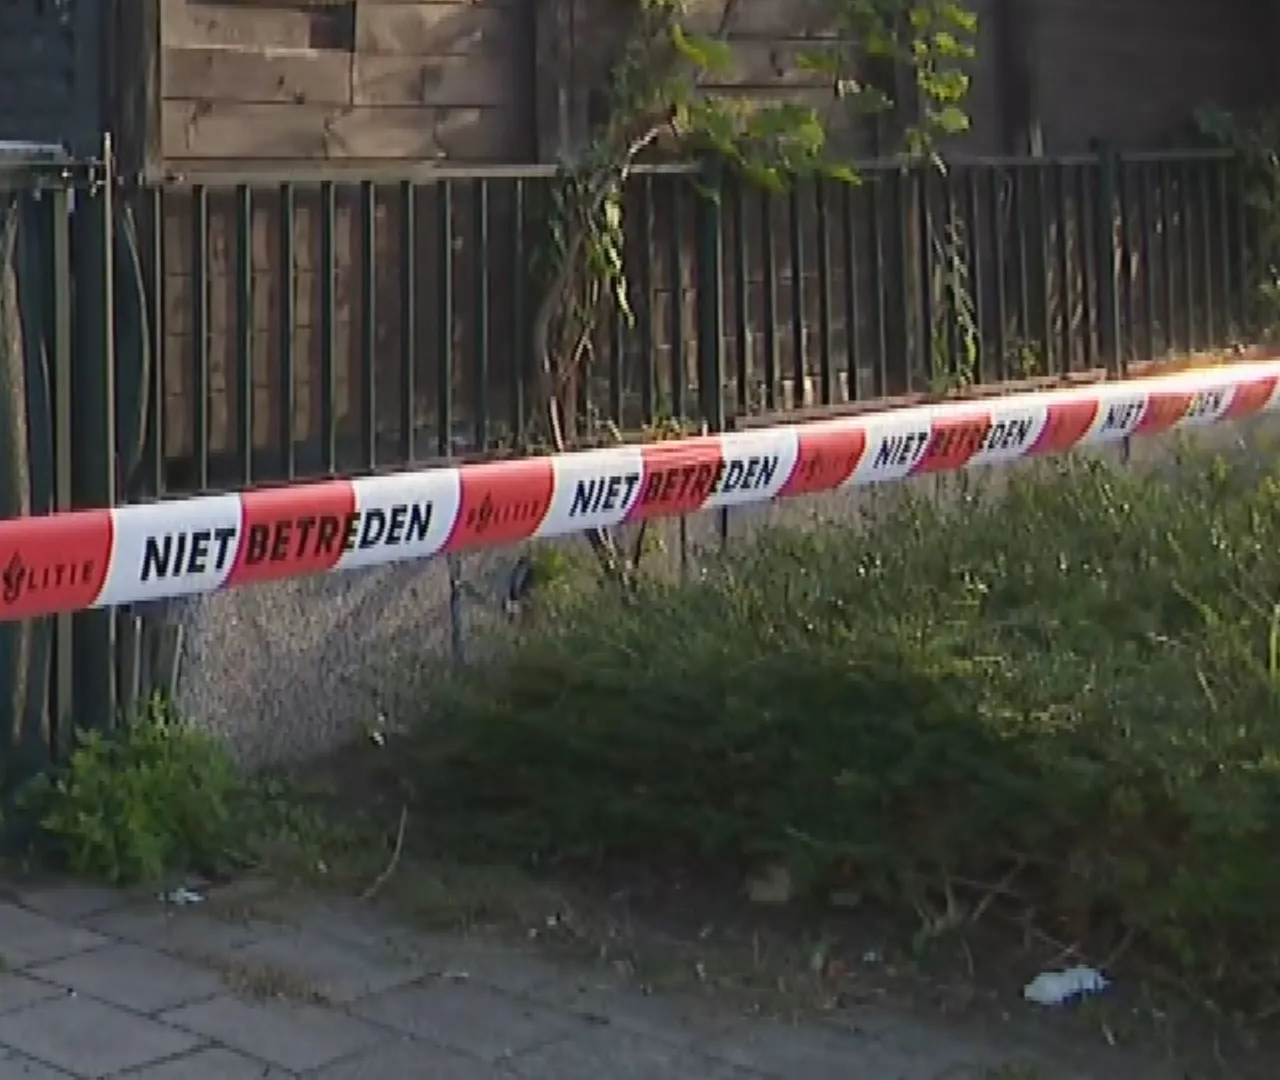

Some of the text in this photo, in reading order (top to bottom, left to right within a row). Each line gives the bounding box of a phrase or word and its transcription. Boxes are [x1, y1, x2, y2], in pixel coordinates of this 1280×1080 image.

[140, 528, 236, 581] NIET
[245, 501, 433, 565] BETREDEN
[569, 472, 640, 517] NIET
[642, 456, 778, 504] BETREDEN
[873, 432, 928, 470] NIET
